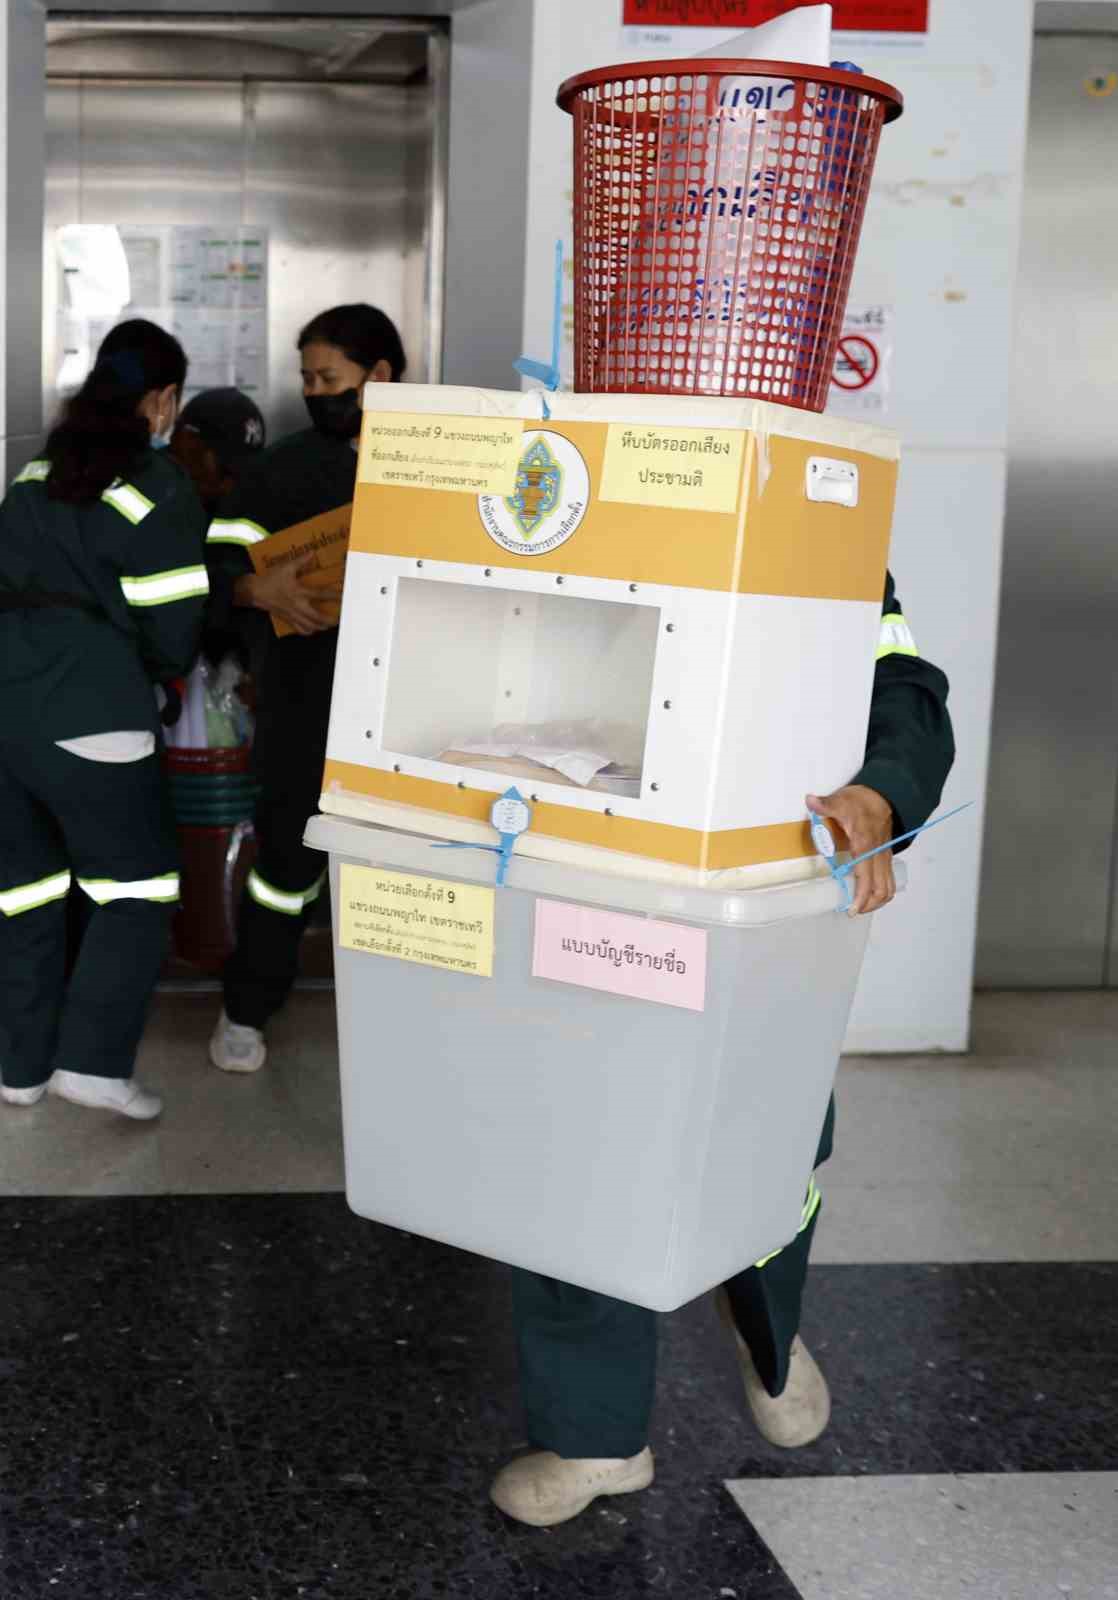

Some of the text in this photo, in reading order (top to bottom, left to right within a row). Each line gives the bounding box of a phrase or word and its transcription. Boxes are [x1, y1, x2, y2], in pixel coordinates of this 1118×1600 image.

[433, 426, 442, 439] 9
[621, 431, 730, 454] หีบบัตรออกเสียง
[638, 468, 703, 487] ประชามติ
[375, 881, 456, 903] หน่วยเลือกตั้งที่ 9
[349, 900, 483, 934] แขวงถนนพญาไท เขตราชเทวี
[404, 946, 410, 956] 2
[561, 937, 686, 974] แบบบัญชีรายชื่อ
